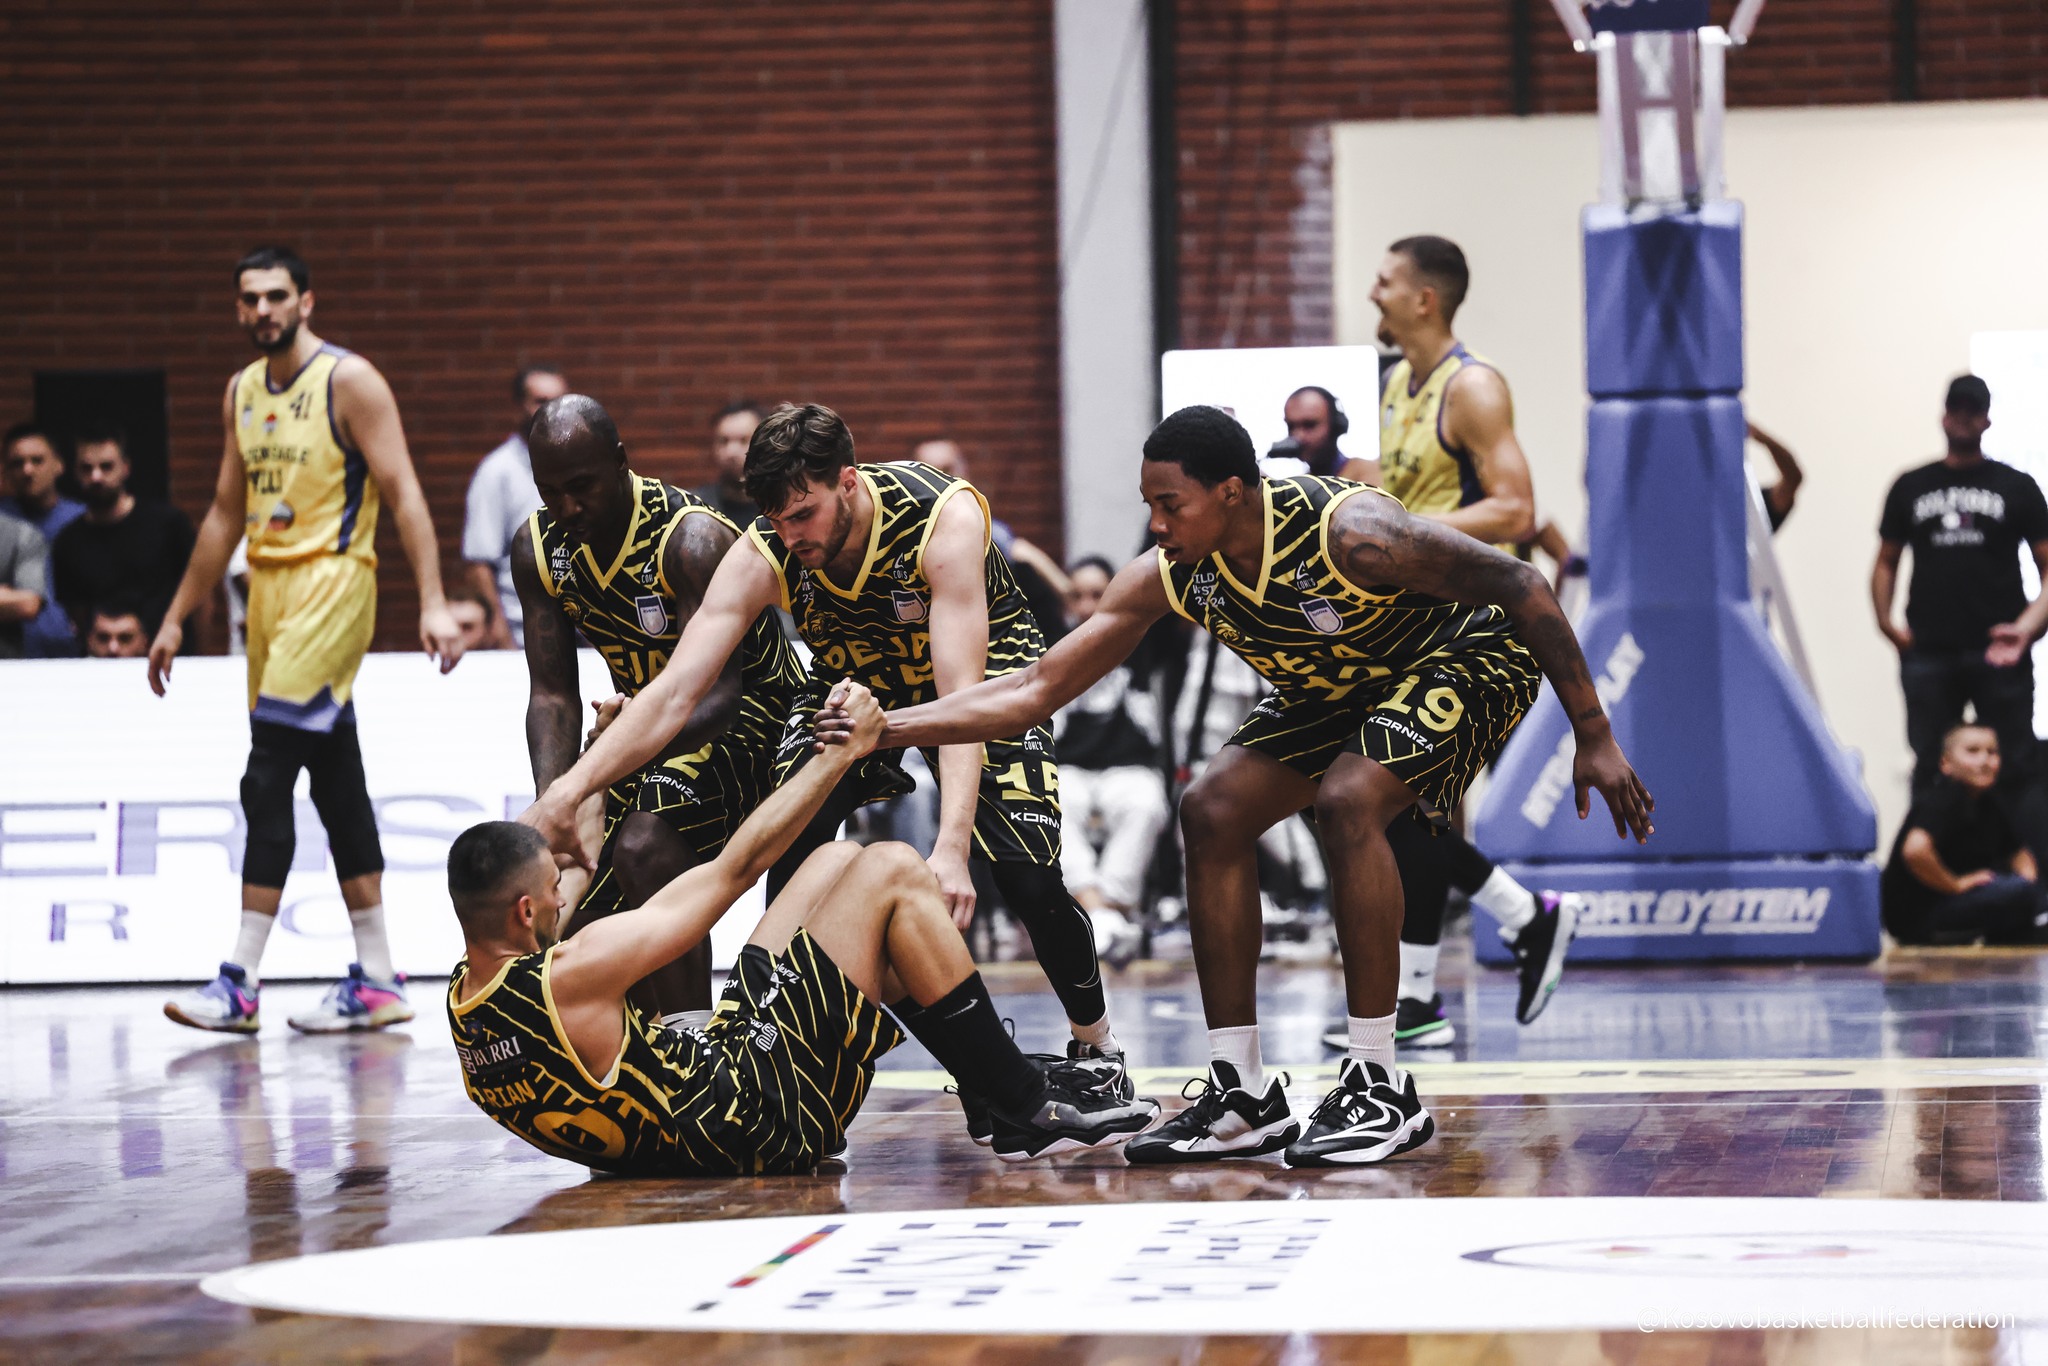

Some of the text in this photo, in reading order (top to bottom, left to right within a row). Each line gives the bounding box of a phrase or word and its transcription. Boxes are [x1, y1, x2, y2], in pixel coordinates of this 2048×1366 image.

[600, 645, 670, 685] EJA
[1376, 674, 1465, 733] 19
[1367, 715, 1435, 754] KORNIZA
[643, 774, 701, 805] KORNIZA
[1010, 811, 1060, 830] KORN
[472, 1035, 522, 1067] BURRI
